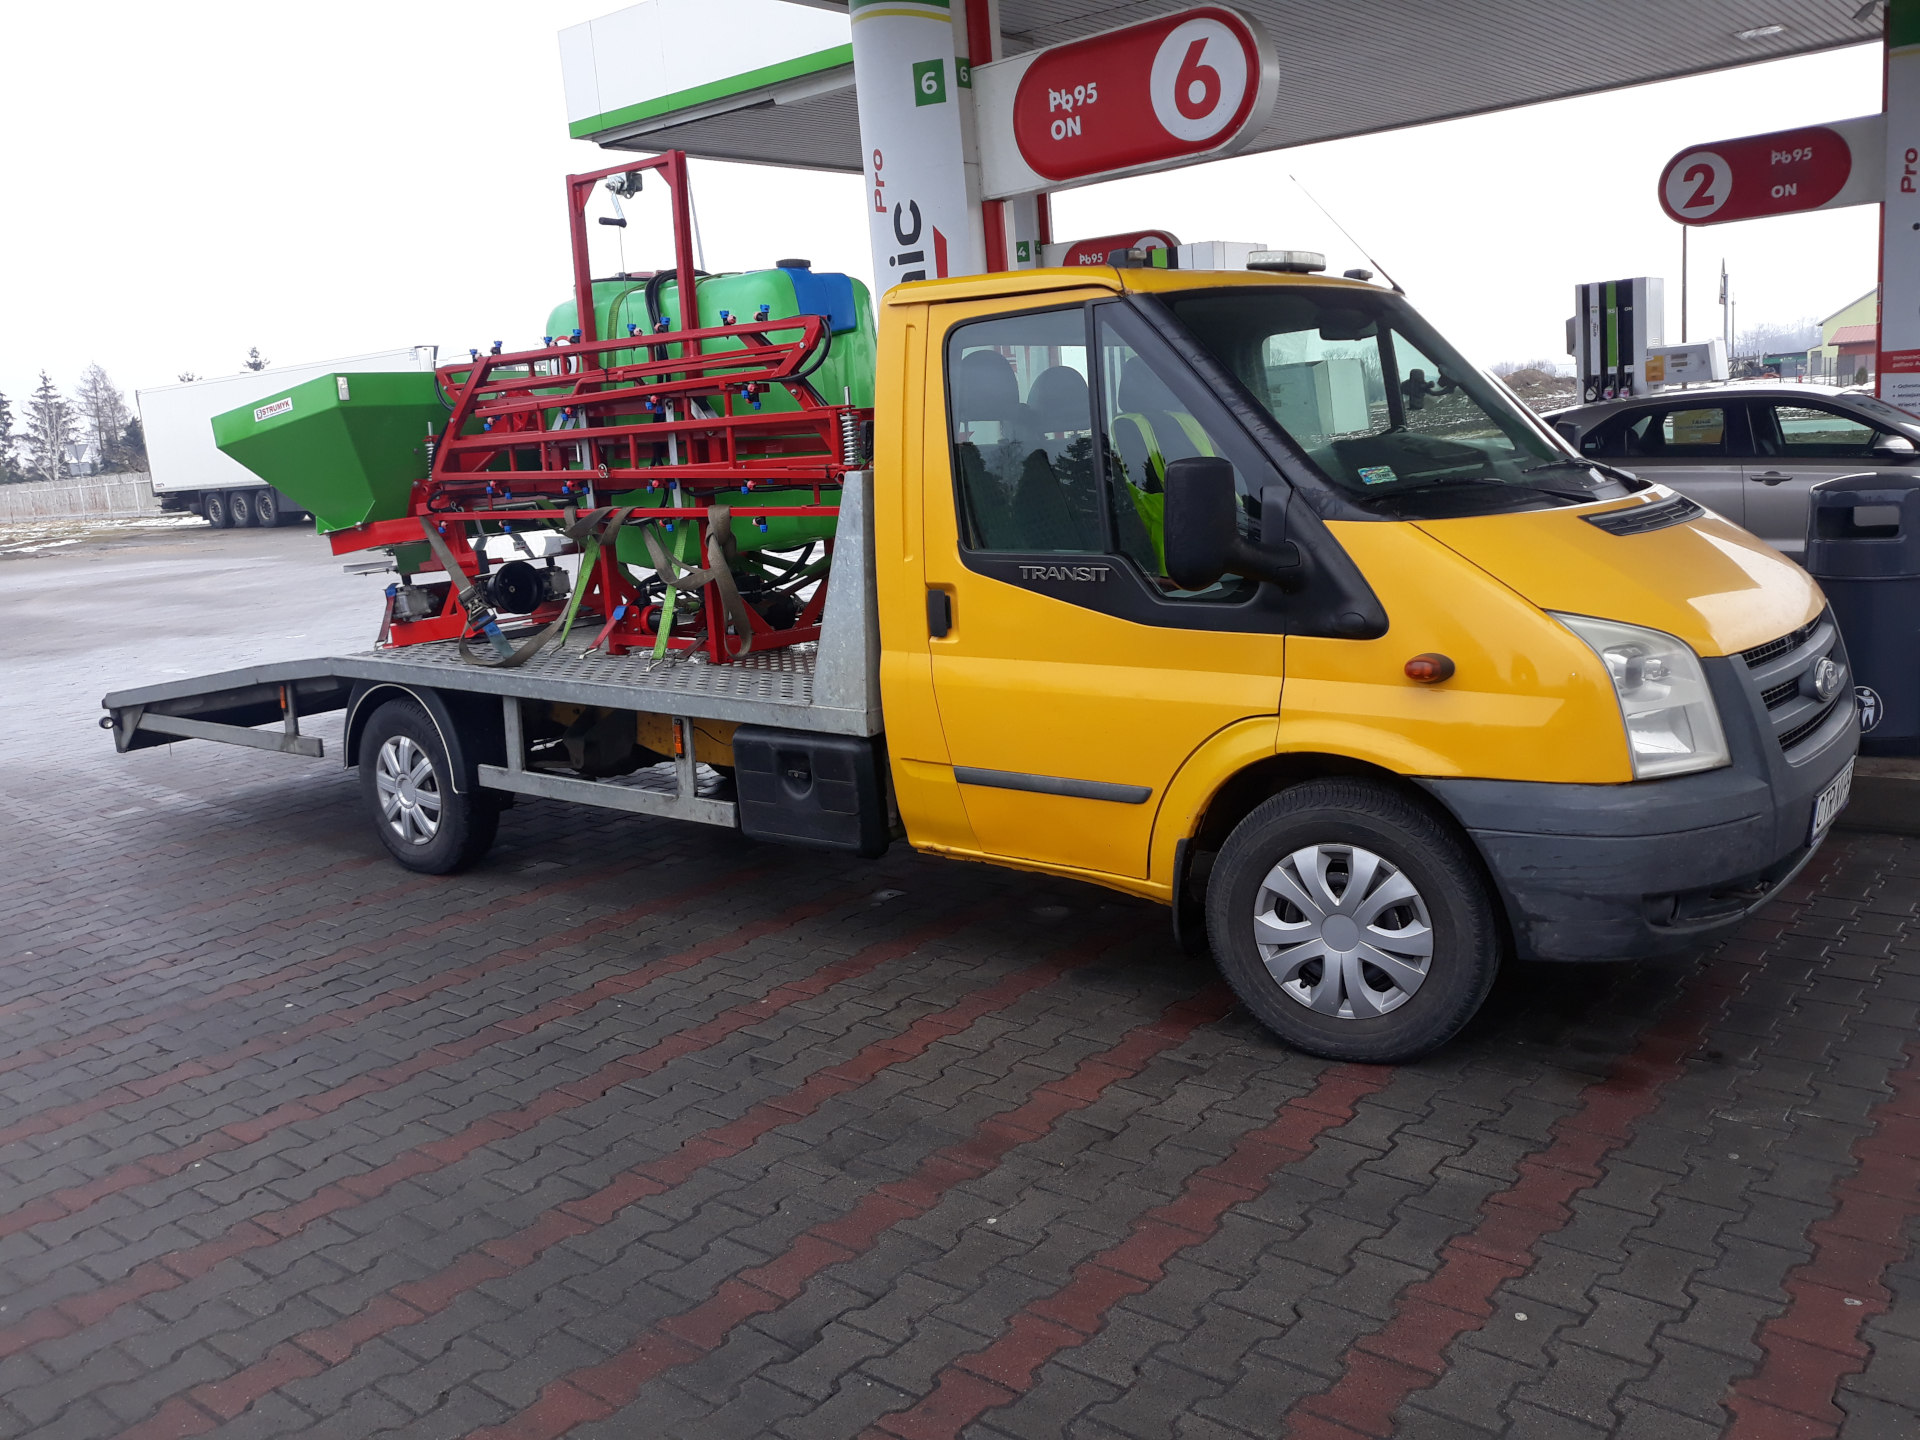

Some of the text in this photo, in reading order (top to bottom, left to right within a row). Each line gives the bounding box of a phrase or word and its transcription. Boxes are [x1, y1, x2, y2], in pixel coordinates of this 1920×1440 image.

[921, 71, 938, 95] 6
[960, 66, 968, 82] 6
[1174, 37, 1222, 121] 6
[1051, 115, 1082, 141] ON
[873, 148, 887, 213] Pro
[1900, 147, 1919, 193] Pro
[1682, 163, 1715, 209] 2
[1771, 182, 1797, 199] ON
[1017, 246, 1027, 257] 4
[262, 400, 290, 416] STRUMYK
[1018, 565, 1110, 583] TRANSIT
